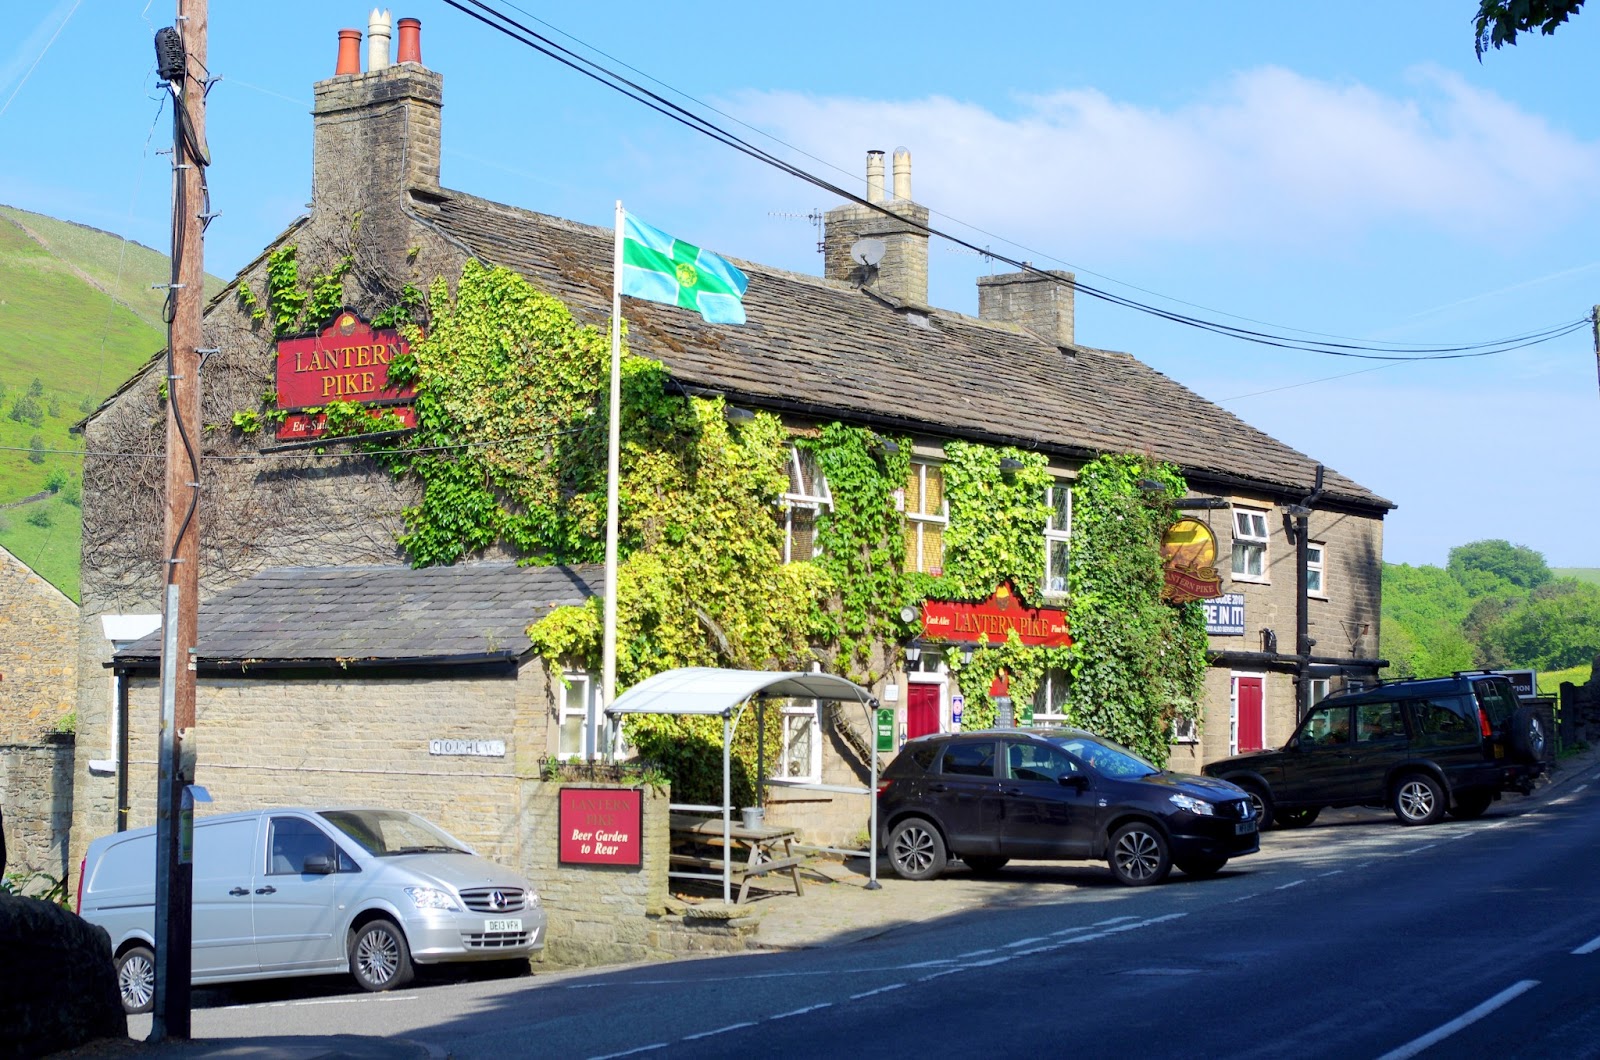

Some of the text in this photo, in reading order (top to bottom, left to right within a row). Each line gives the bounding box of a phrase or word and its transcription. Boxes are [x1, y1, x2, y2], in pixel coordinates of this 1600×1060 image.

[294, 342, 405, 373] LANTERN
[321, 372, 375, 397] PIKE
[1165, 571, 1215, 593] ANTERN PIKE
[1202, 604, 1244, 625] RE IN IT!
[953, 612, 1017, 635] LANTERN
[1019, 618, 1049, 638] PIKE
[570, 799, 631, 812] LANTERN
[585, 814, 615, 826] PIKE
[571, 828, 629, 843] Beer Garden
[580, 842, 619, 856] to Rear
[489, 921, 505, 931] DE13
